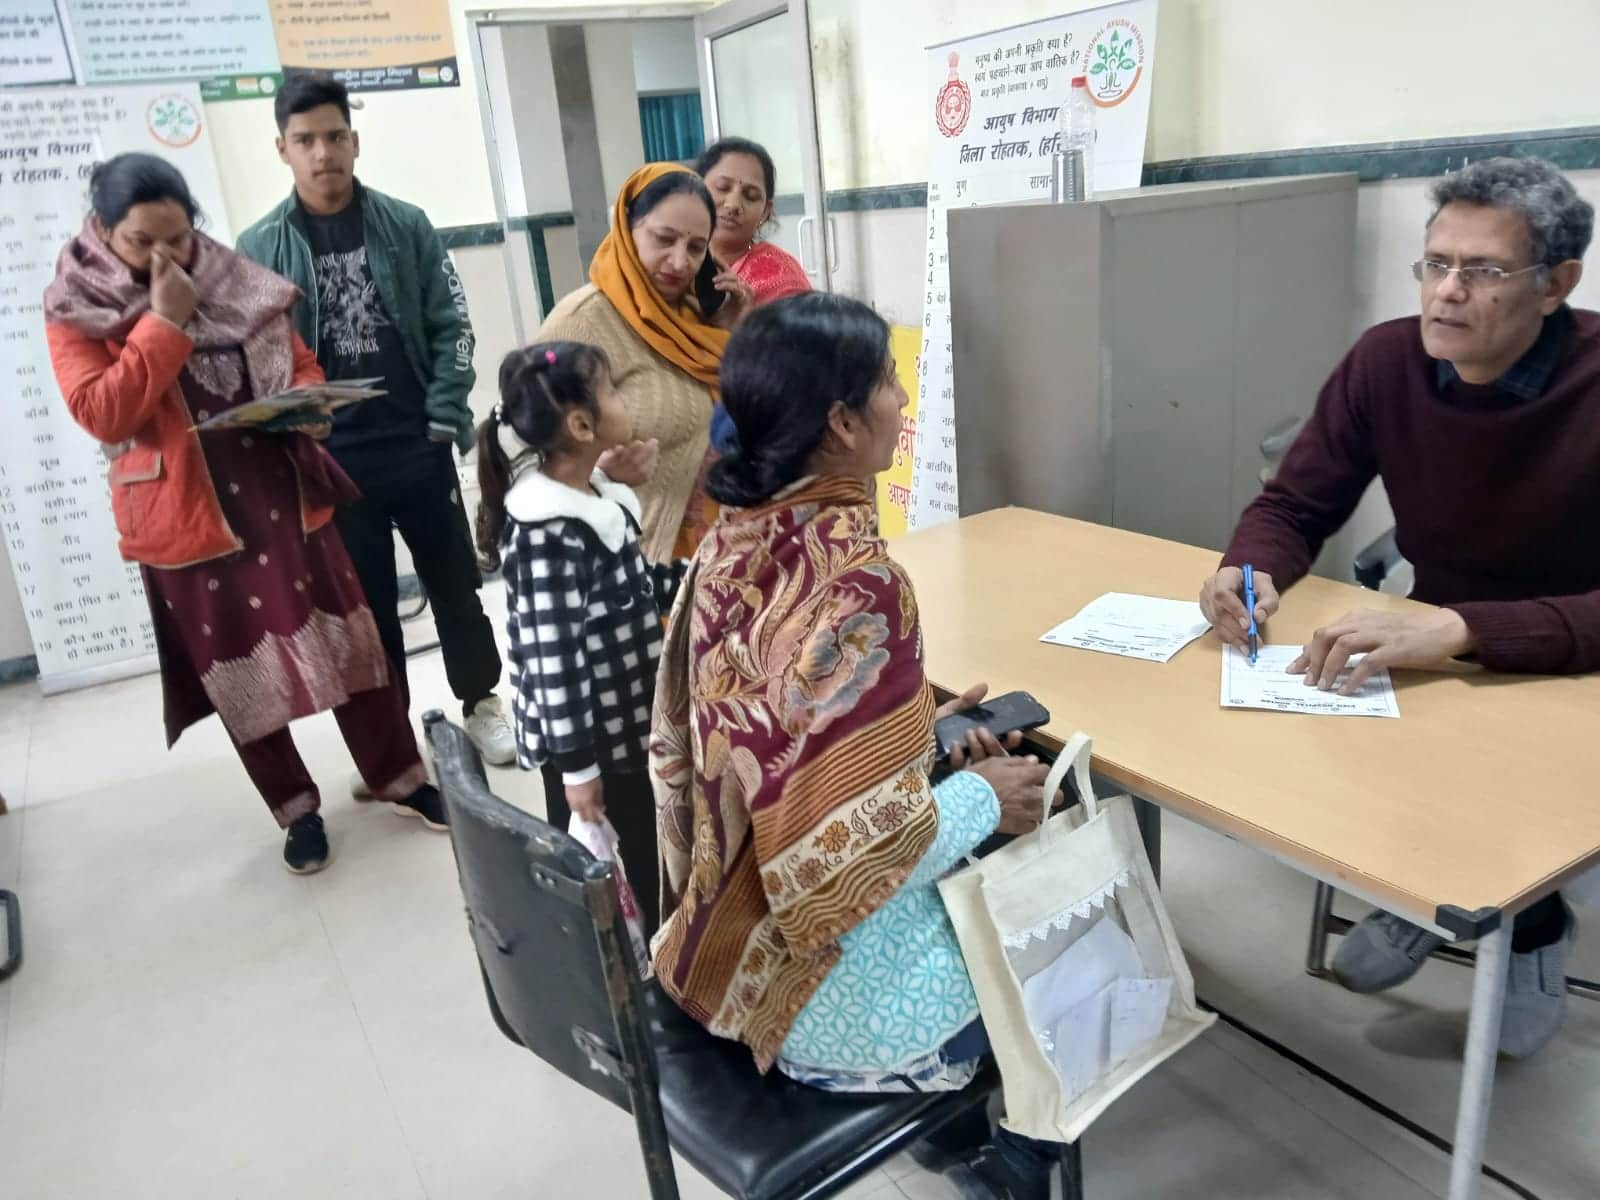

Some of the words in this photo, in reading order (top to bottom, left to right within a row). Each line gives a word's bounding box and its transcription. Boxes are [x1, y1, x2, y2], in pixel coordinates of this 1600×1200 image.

[993, 48, 1003, 62] की
[1030, 59, 1043, 73] आप
[982, 111, 1017, 135] आयुष
[1022, 105, 1061, 126] विभाग
[47, 142, 92, 156] विभाग
[960, 144, 987, 165] जिला
[929, 226, 935, 240] 2
[928, 252, 934, 268] 3
[928, 270, 933, 285] 4
[926, 291, 932, 304] 5
[925, 312, 931, 327] 6
[924, 339, 930, 353] 7
[922, 361, 928, 377] 8
[920, 384, 926, 399] 9
[6, 521, 20, 534] 14
[11, 538, 26, 551] 15
[17, 561, 32, 574] 16
[23, 584, 37, 597] 17
